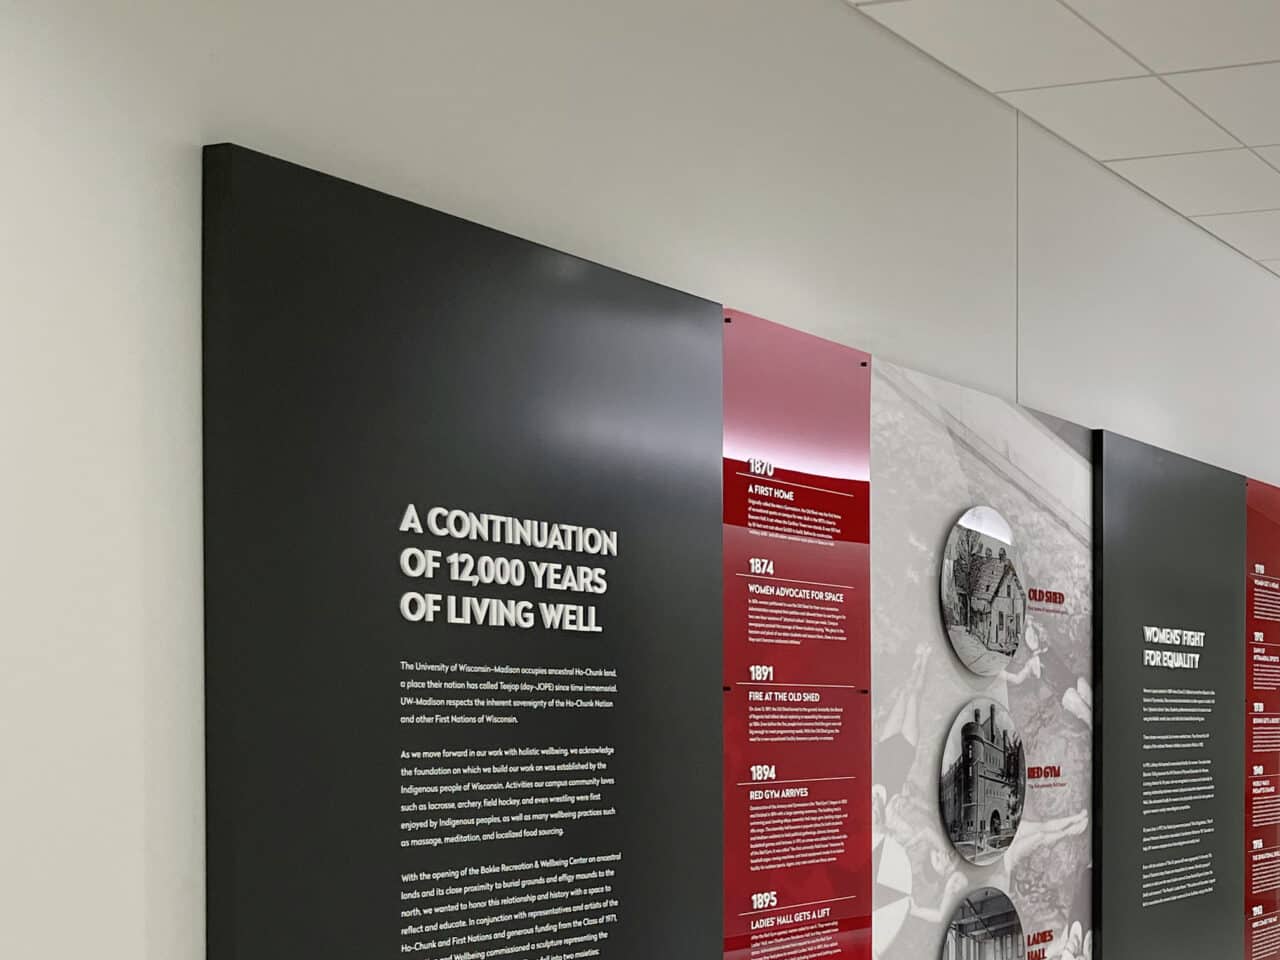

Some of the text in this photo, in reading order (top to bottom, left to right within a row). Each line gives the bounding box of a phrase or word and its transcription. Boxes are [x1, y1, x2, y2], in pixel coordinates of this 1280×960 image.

[748, 484, 794, 501] A FIRST HOME
[399, 503, 618, 556] A CONTINUATION
[399, 547, 608, 594] OF 12,000 YEARS
[749, 558, 774, 575] 1874
[748, 584, 844, 602] WOMEN ADVOCATE FOR SPACE
[1028, 588, 1065, 604] OLD SHED
[400, 591, 602, 632] OF LIVING WELL
[1182, 631, 1205, 648] FIGHT
[401, 660, 414, 671] The
[415, 661, 449, 674] University
[450, 663, 457, 672] of
[1143, 650, 1200, 670] FOR EQUALITY
[749, 665, 774, 681] 1891
[400, 680, 405, 688] a
[406, 679, 425, 690] place
[427, 679, 442, 689] their
[443, 680, 465, 689] nation
[466, 680, 478, 690] has
[479, 680, 498, 690] called
[446, 698, 473, 709] respects
[474, 697, 485, 707] the
[749, 691, 820, 702] FIRE AT THE OLD SHED
[400, 714, 415, 724] and
[415, 714, 434, 724] other
[435, 714, 450, 724] First
[450, 714, 476, 724] Nations
[477, 714, 484, 724] of
[401, 750, 410, 759] As
[411, 751, 421, 759] we
[442, 748, 468, 758] forward
[468, 749, 475, 757] in
[488, 747, 503, 757] work
[504, 747, 517, 756] with
[518, 747, 539, 756] holistic
[400, 767, 413, 777] the
[414, 766, 451, 776] foundation
[452, 767, 461, 775] on
[462, 765, 481, 774] which
[492, 764, 508, 773] build
[509, 765, 519, 773] our
[750, 765, 776, 781] 1894
[1027, 766, 1061, 779] RED GYM
[400, 784, 438, 796] Indigenous
[439, 782, 462, 794] people
[463, 782, 470, 791] of
[505, 780, 533, 789] Activities
[749, 788, 809, 801] RED GYM ARRIVES
[401, 802, 417, 812] such
[418, 803, 427, 811] as
[483, 797, 497, 807] field
[401, 839, 409, 847] as
[482, 831, 495, 841] and
[495, 829, 523, 839] localized
[751, 891, 777, 909] 1895
[776, 915, 794, 926] HALL
[794, 911, 811, 923] GETS
[811, 910, 817, 919] A
[817, 907, 831, 919] LIFT
